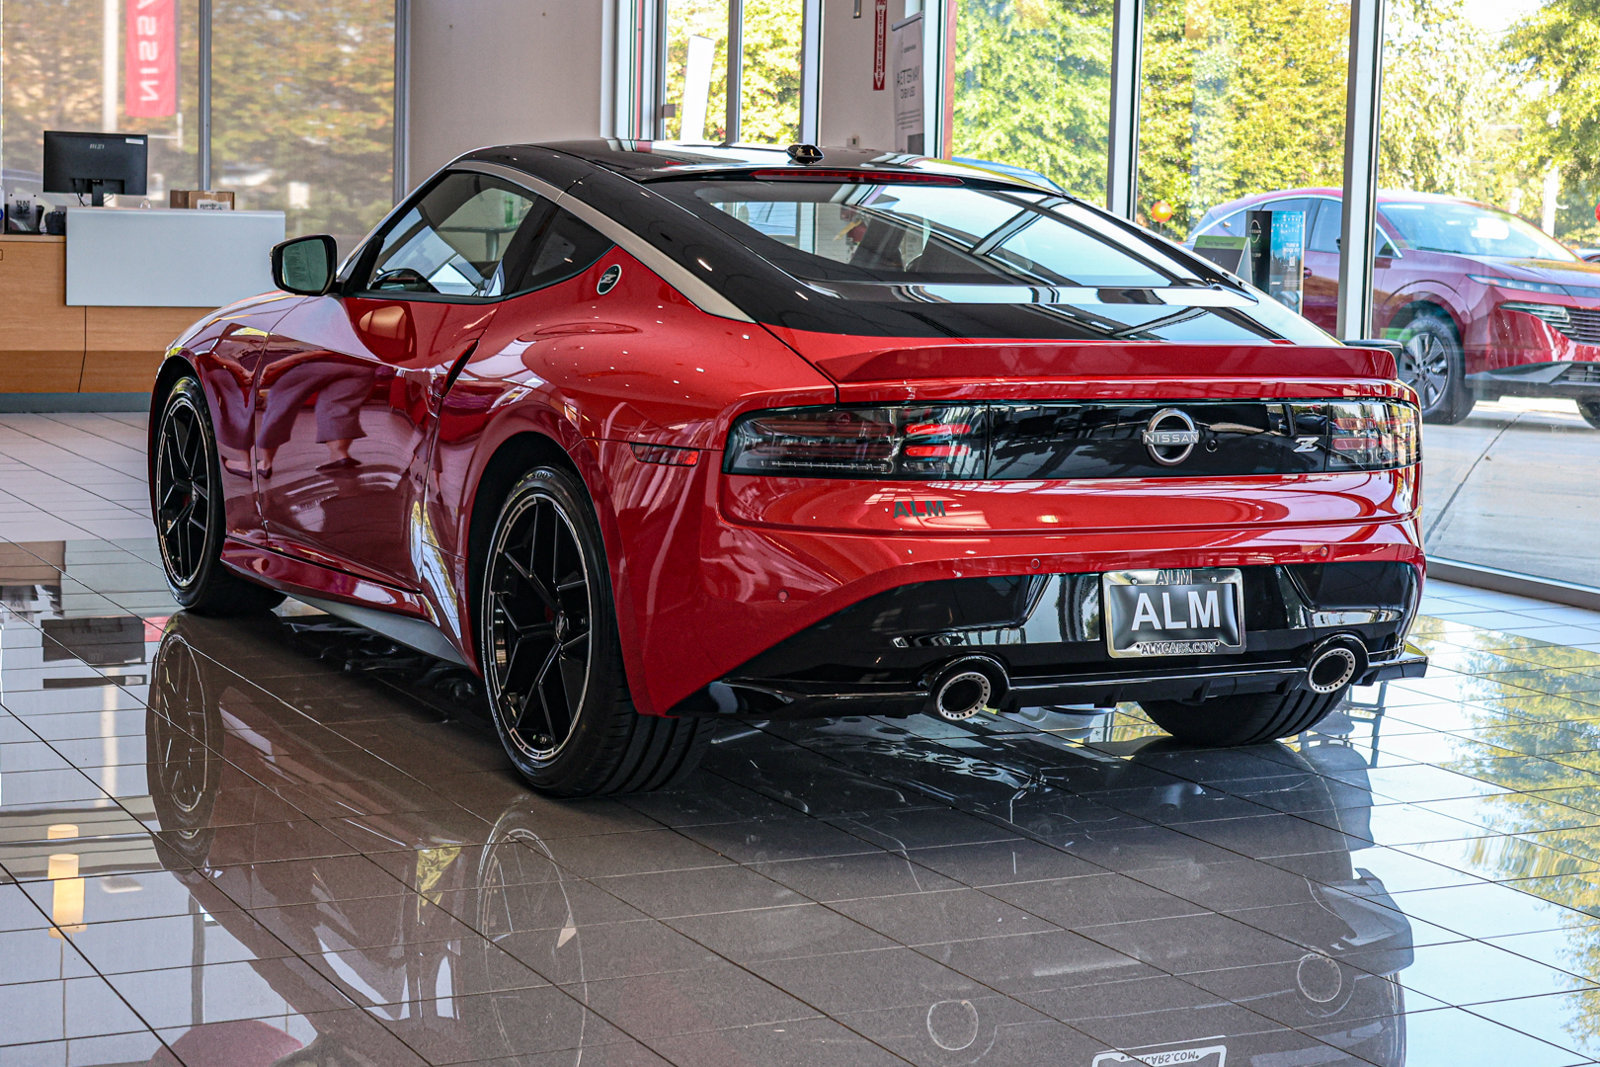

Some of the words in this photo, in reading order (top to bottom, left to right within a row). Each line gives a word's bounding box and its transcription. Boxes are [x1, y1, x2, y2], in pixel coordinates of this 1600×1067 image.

[1144, 434, 1198, 444] NISSAN
[1293, 437, 1319, 452] Z
[893, 500, 946, 518] ALM
[1156, 569, 1193, 585] ALM
[1131, 590, 1220, 631] ALM
[1141, 641, 1216, 655] ALMCARS.COM
